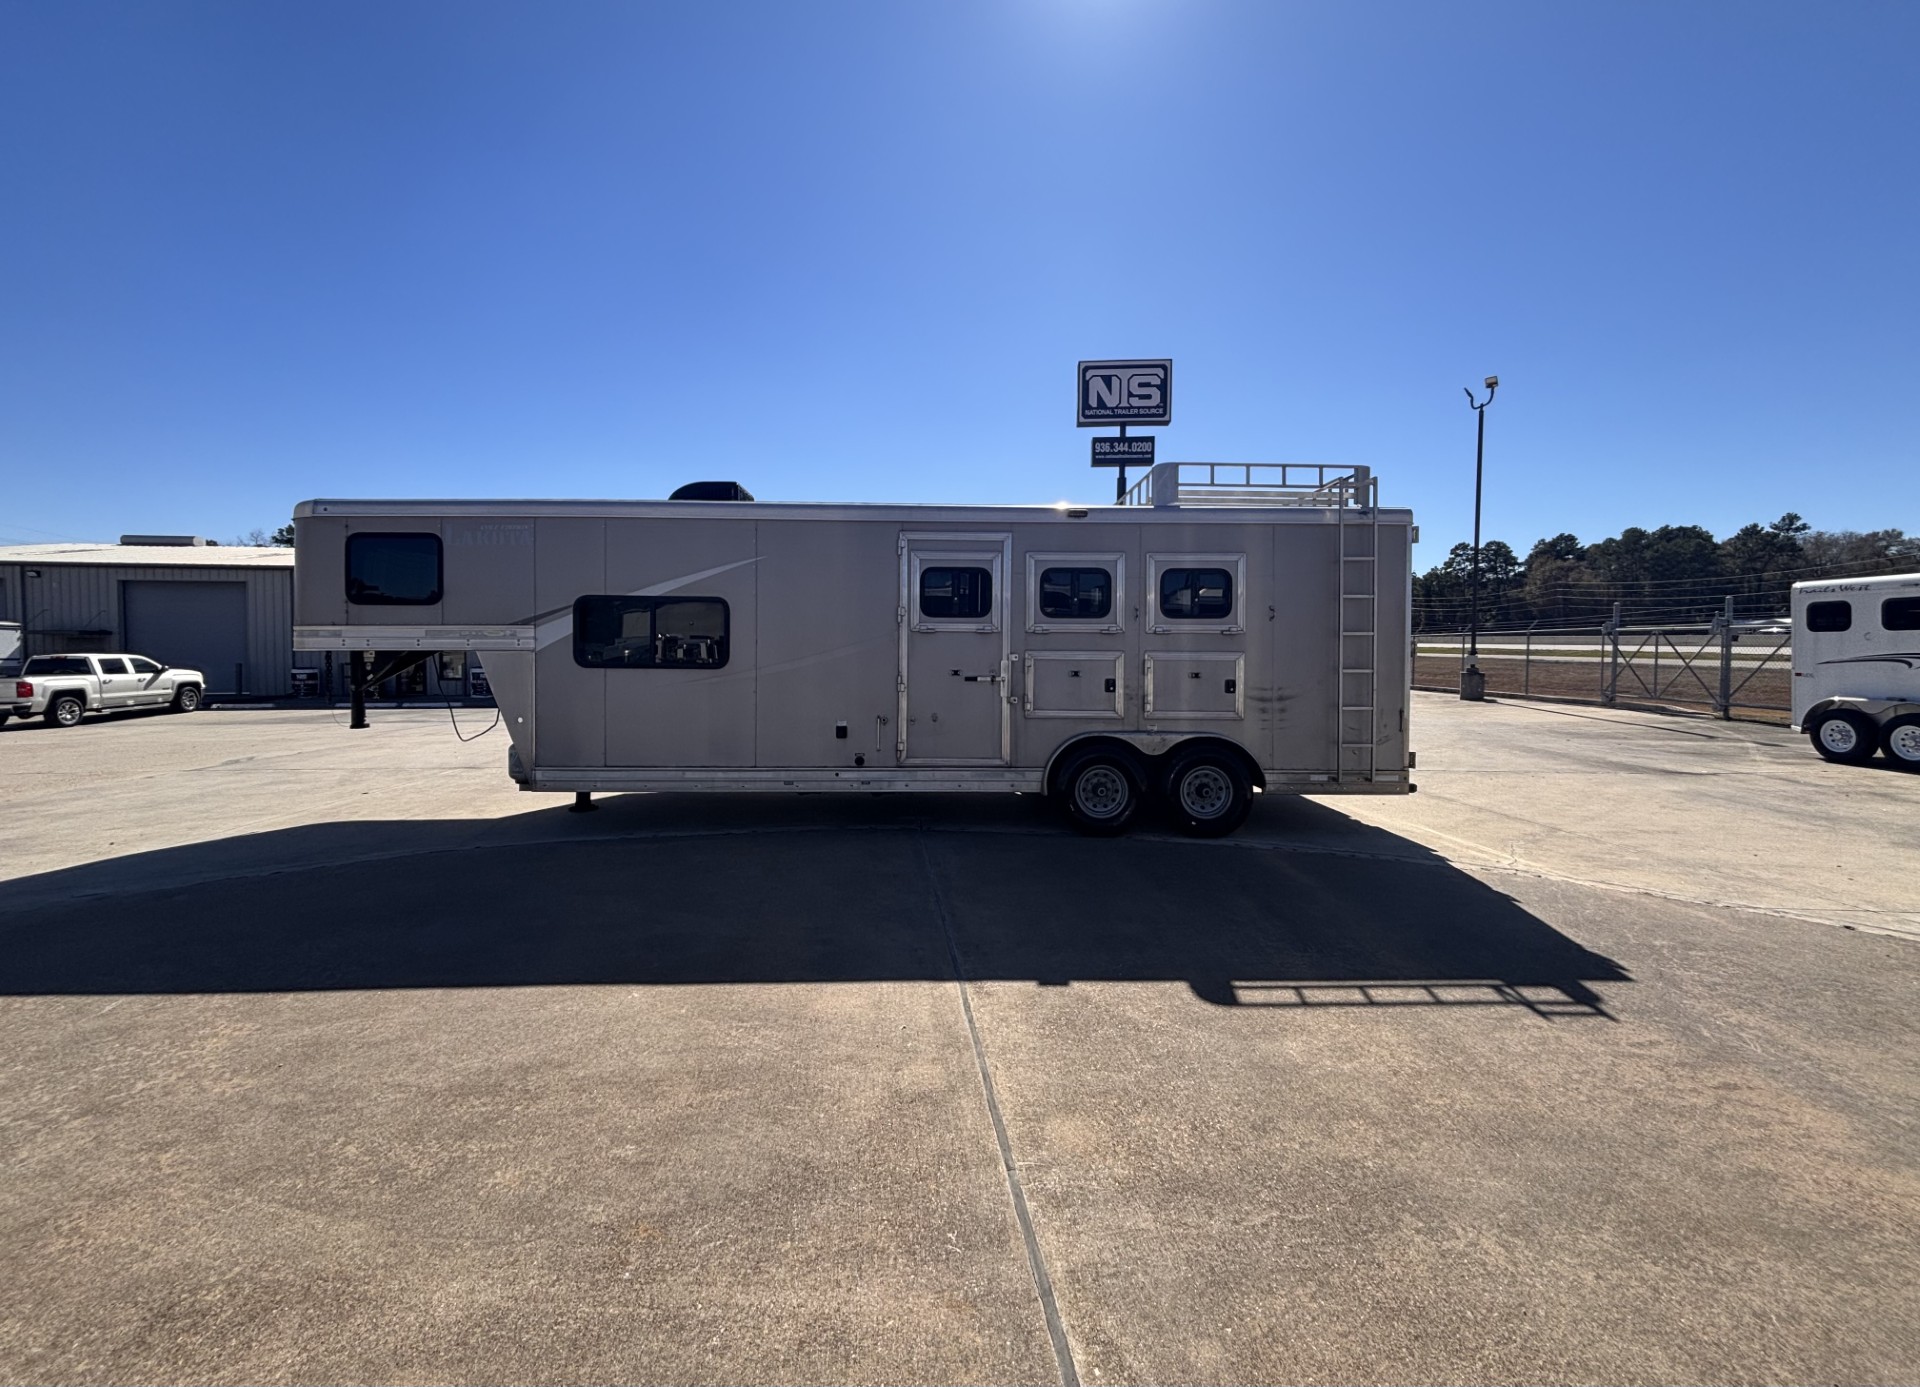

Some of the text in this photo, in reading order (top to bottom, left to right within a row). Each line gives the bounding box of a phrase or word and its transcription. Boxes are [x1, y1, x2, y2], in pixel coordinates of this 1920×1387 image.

[1086, 367, 1164, 407] NTS
[1095, 442, 1152, 452] 936.344.0200
[1799, 586, 1835, 594] Trails
